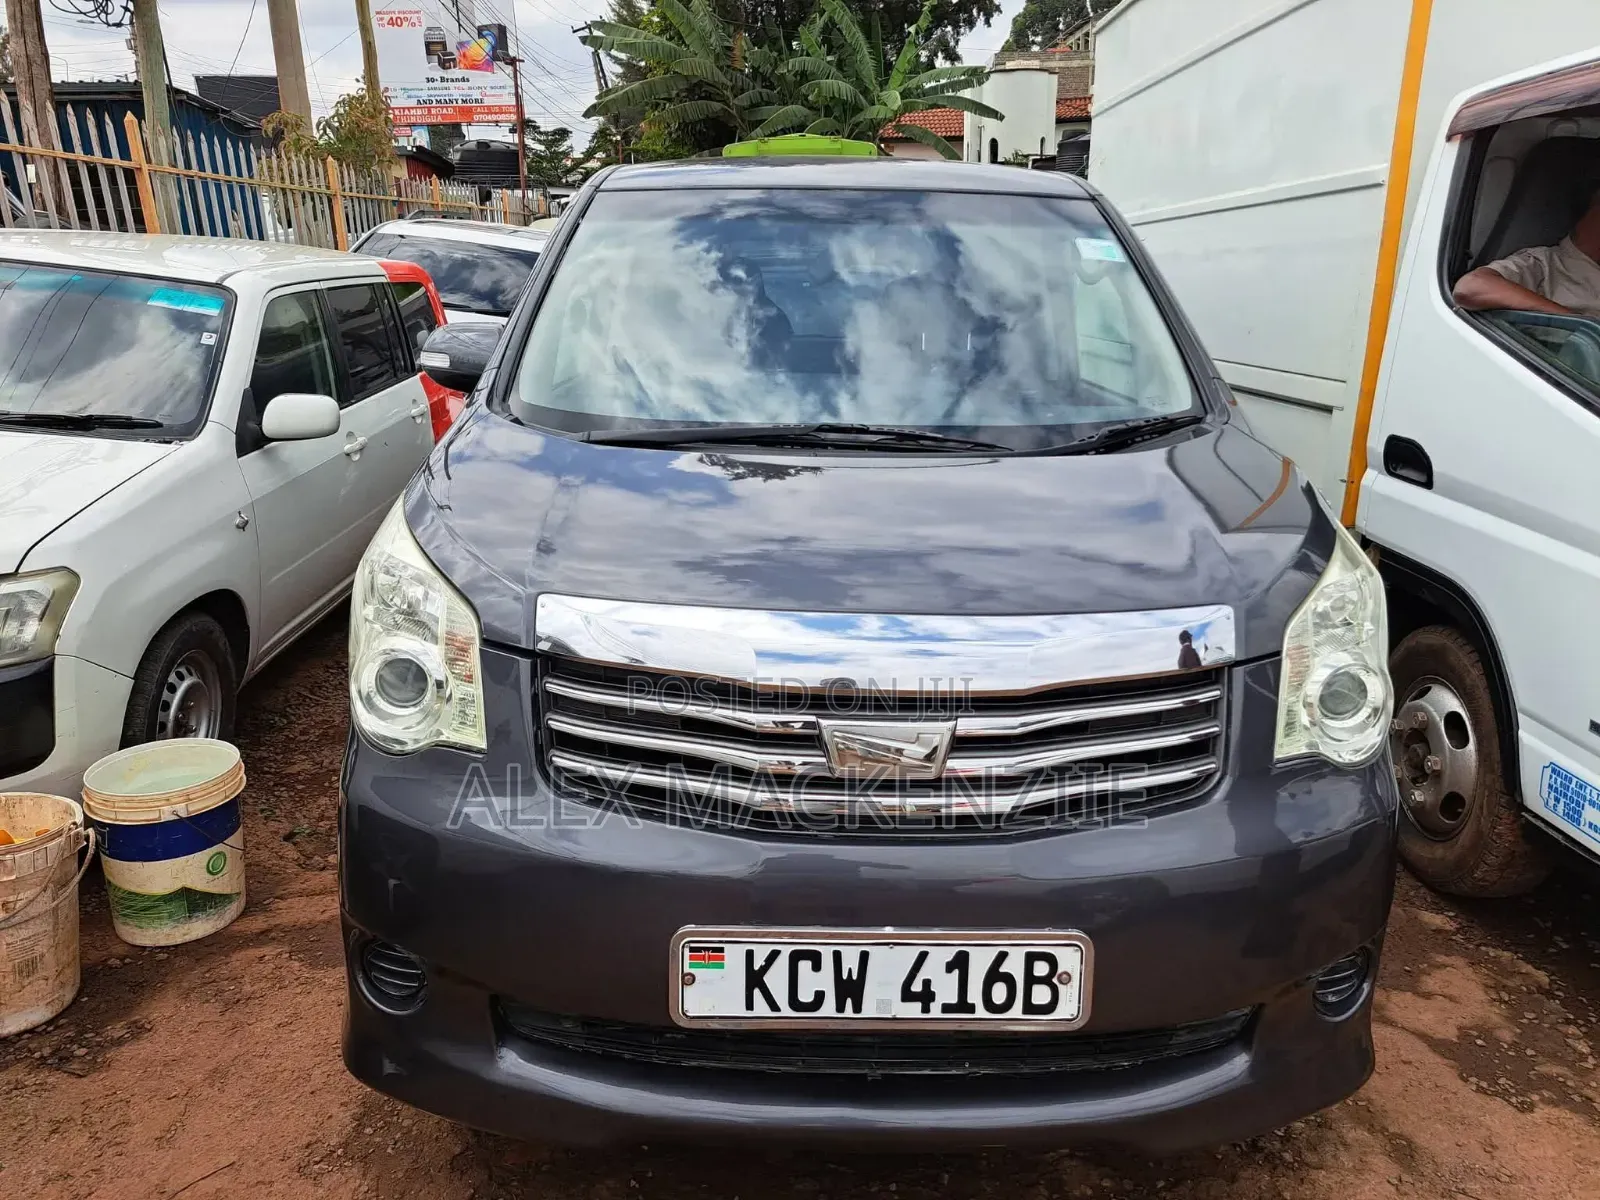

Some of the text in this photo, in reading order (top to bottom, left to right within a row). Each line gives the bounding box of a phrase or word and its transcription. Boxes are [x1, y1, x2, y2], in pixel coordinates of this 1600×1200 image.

[387, 16, 416, 28] 40%
[439, 75, 470, 83] Brands
[430, 106, 456, 115] ROAD,
[395, 115, 443, 123] THINDIGUA
[1560, 780, 1570, 793] BOX
[1548, 783, 1585, 811] NAIROBI
[1563, 801, 1582, 818] 1500
[1562, 808, 1581, 826] 1400
[745, 949, 1060, 1016] KCW 416B
